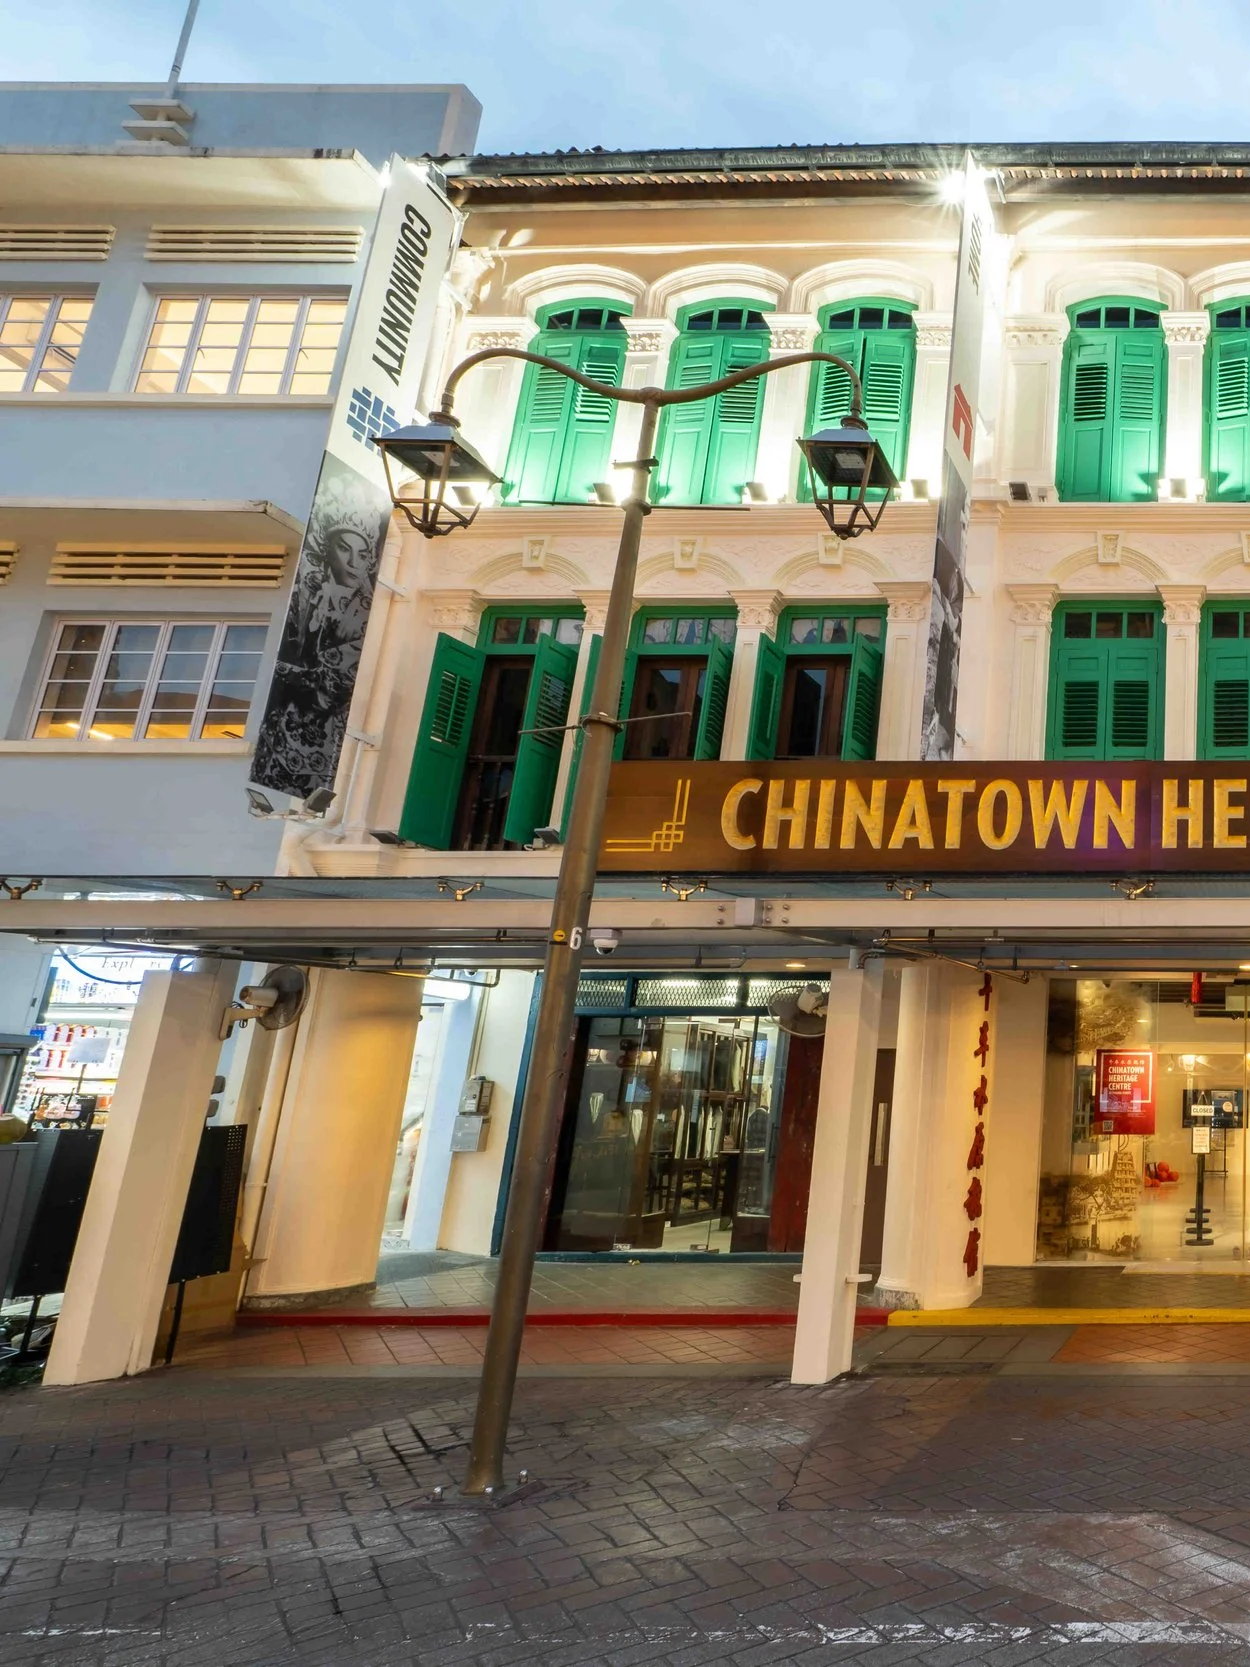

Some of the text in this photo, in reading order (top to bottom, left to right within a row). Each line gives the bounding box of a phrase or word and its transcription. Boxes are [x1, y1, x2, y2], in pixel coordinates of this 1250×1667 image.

[372, 204, 432, 386] COMMUNITY
[721, 778, 1135, 851] CHINATOWN
[570, 927, 582, 950] 6
[1108, 1066, 1145, 1074] CHINATOWN
[1108, 1082, 1132, 1091] CENTRE
